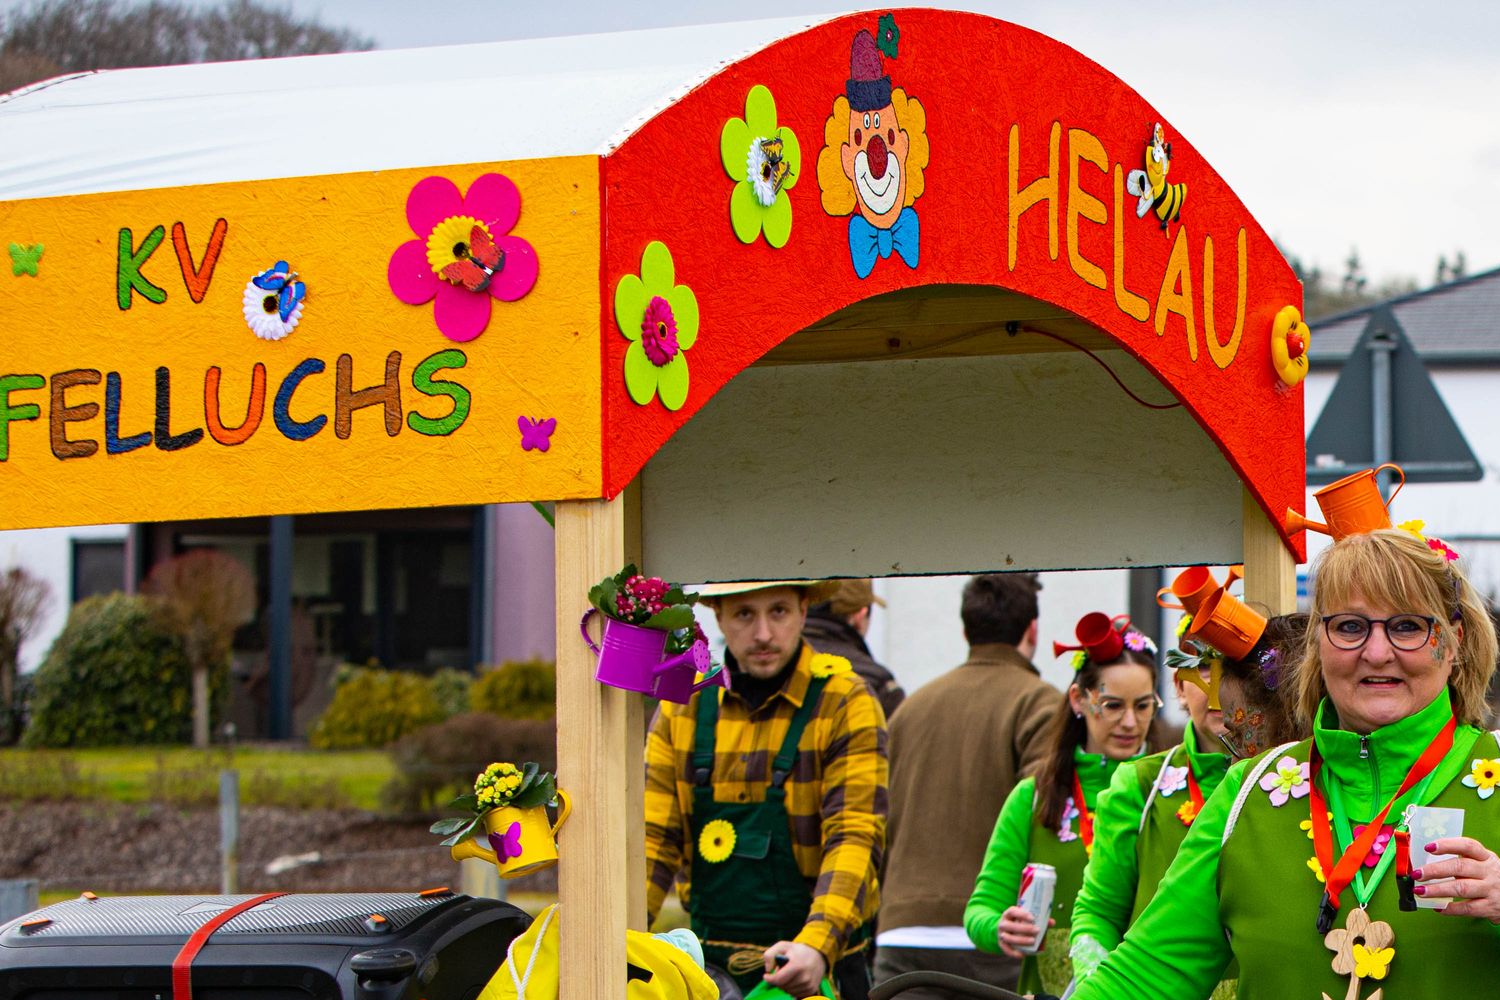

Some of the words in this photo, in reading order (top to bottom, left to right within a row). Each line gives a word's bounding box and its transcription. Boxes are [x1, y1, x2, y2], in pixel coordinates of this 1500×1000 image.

[117, 217, 228, 310] KV
[1007, 120, 1247, 370] HELAU
[0, 349, 471, 462] FELLUCHS
